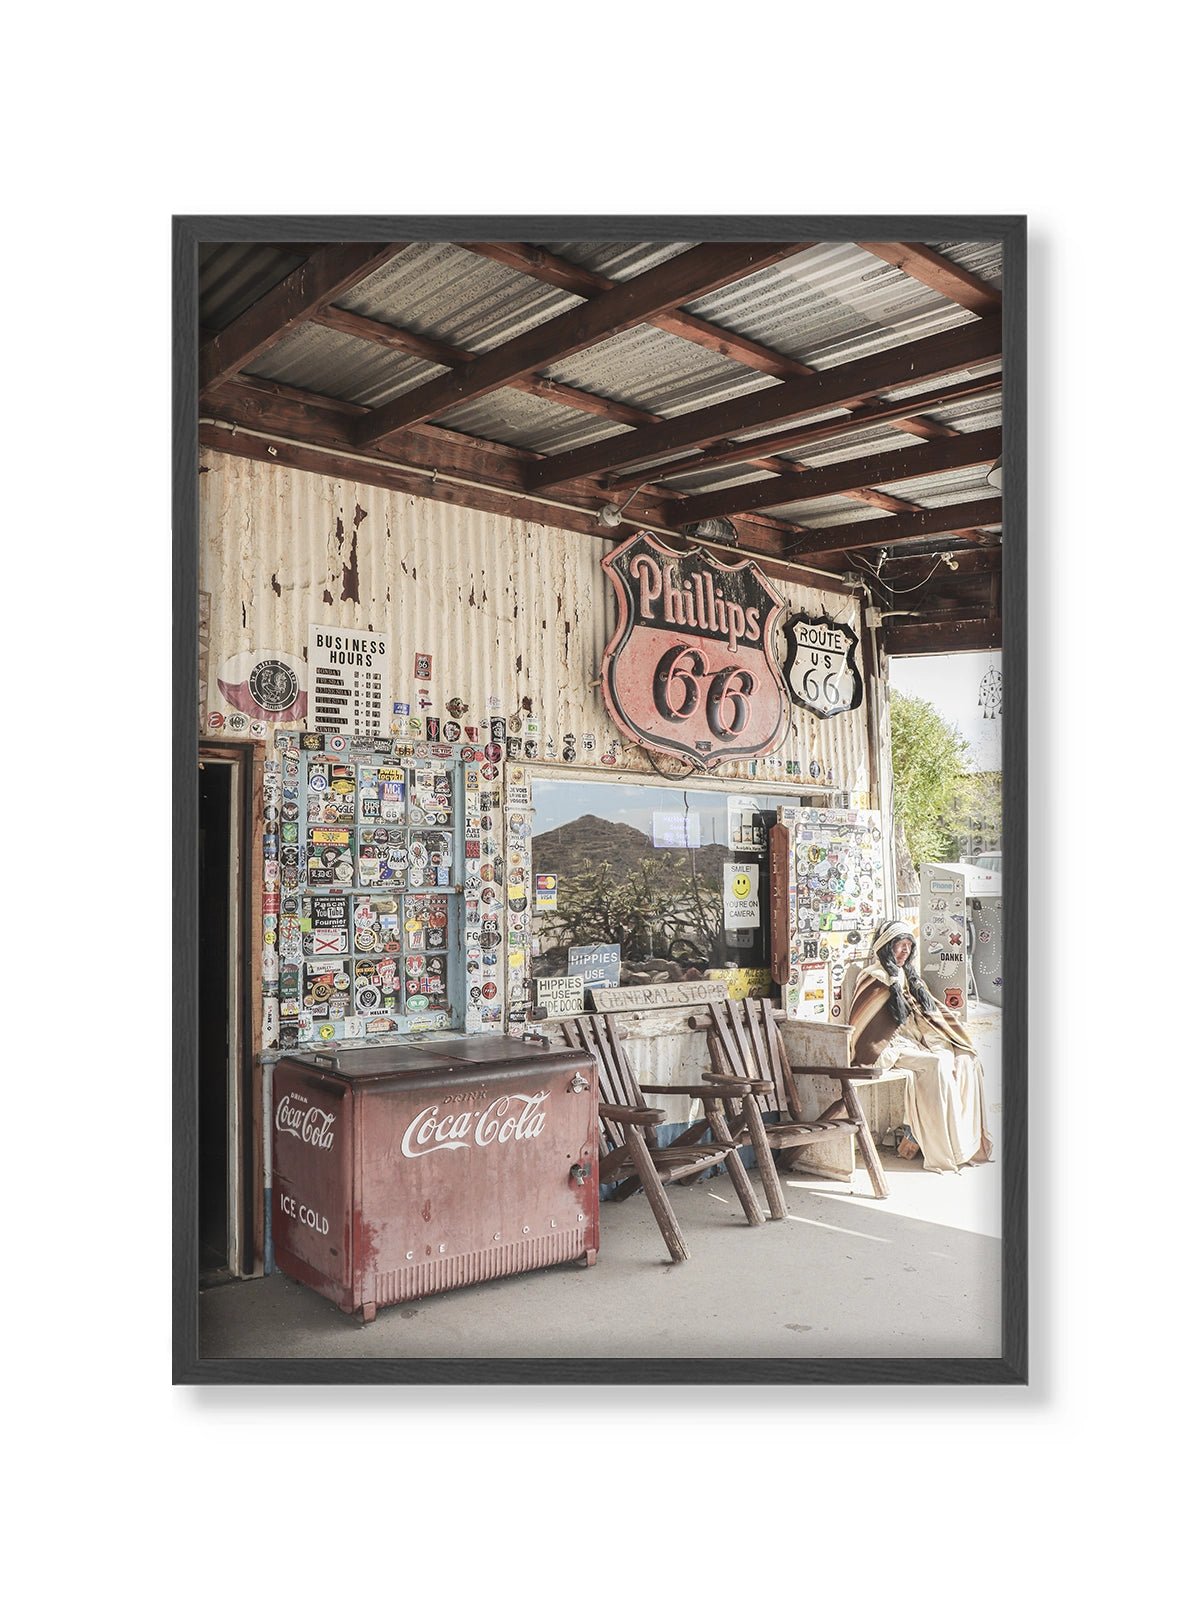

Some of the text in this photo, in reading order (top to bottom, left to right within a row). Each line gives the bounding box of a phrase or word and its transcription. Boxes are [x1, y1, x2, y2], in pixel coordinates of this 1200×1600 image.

[630, 554, 760, 652] Phillips
[317, 634, 385, 655] BUSINESS
[800, 629, 842, 650] ROUTE
[330, 651, 372, 667] HOURS
[653, 645, 760, 742] 66
[803, 669, 839, 704] 66
[731, 865, 751, 873] SMILE!
[932, 882, 952, 890] Phone
[571, 952, 618, 965] HIPPIES
[941, 953, 963, 962] DANKE
[585, 969, 605, 980] USE
[540, 978, 582, 990] HIPPIES
[552, 990, 570, 999] USE
[600, 984, 727, 1009] GENERAL STORE
[560, 998, 583, 1012] DOOR
[290, 1092, 308, 1104] DRINK
[444, 1090, 488, 1104] DRINK
[280, 1193, 329, 1235] ICE COLD
